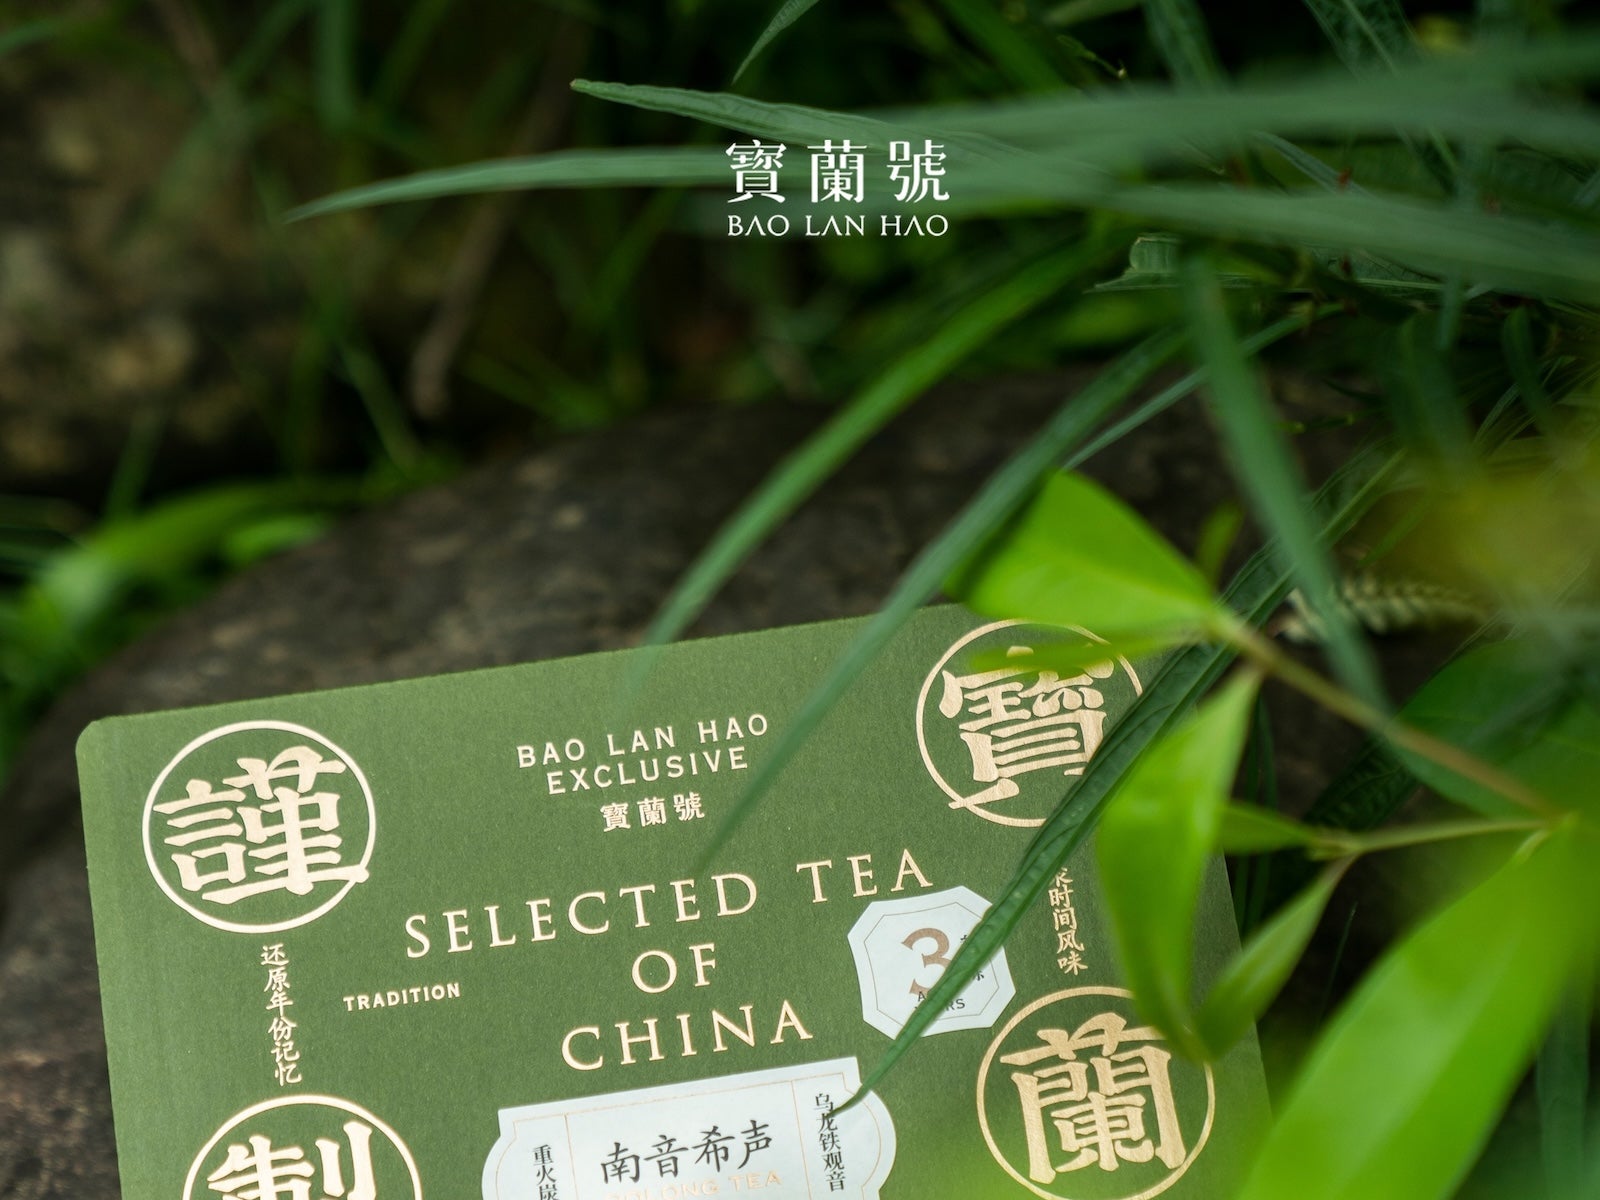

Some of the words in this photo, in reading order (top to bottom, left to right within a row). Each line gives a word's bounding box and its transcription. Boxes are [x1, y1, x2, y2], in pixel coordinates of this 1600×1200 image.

[517, 738, 585, 768] BAO
[607, 725, 675, 756] LAN
[697, 713, 768, 744] HAO
[546, 746, 748, 795] EXCLUSIVE
[153, 745, 369, 905] 謹
[600, 791, 705, 832] 寶蘭號
[405, 872, 758, 959] SELECTED
[796, 848, 934, 904] TEA
[631, 943, 717, 994] OF
[901, 927, 952, 995] 3
[260, 943, 302, 1086] 还原年份记忆
[343, 982, 461, 1012] TRADITION
[561, 1000, 813, 1071] CHINA
[1000, 1012, 1187, 1184] 蘭
[600, 1119, 772, 1185] 南音希声
[814, 1093, 846, 1192] 乌龙铁观音
[728, 1171, 782, 1191] TEA
